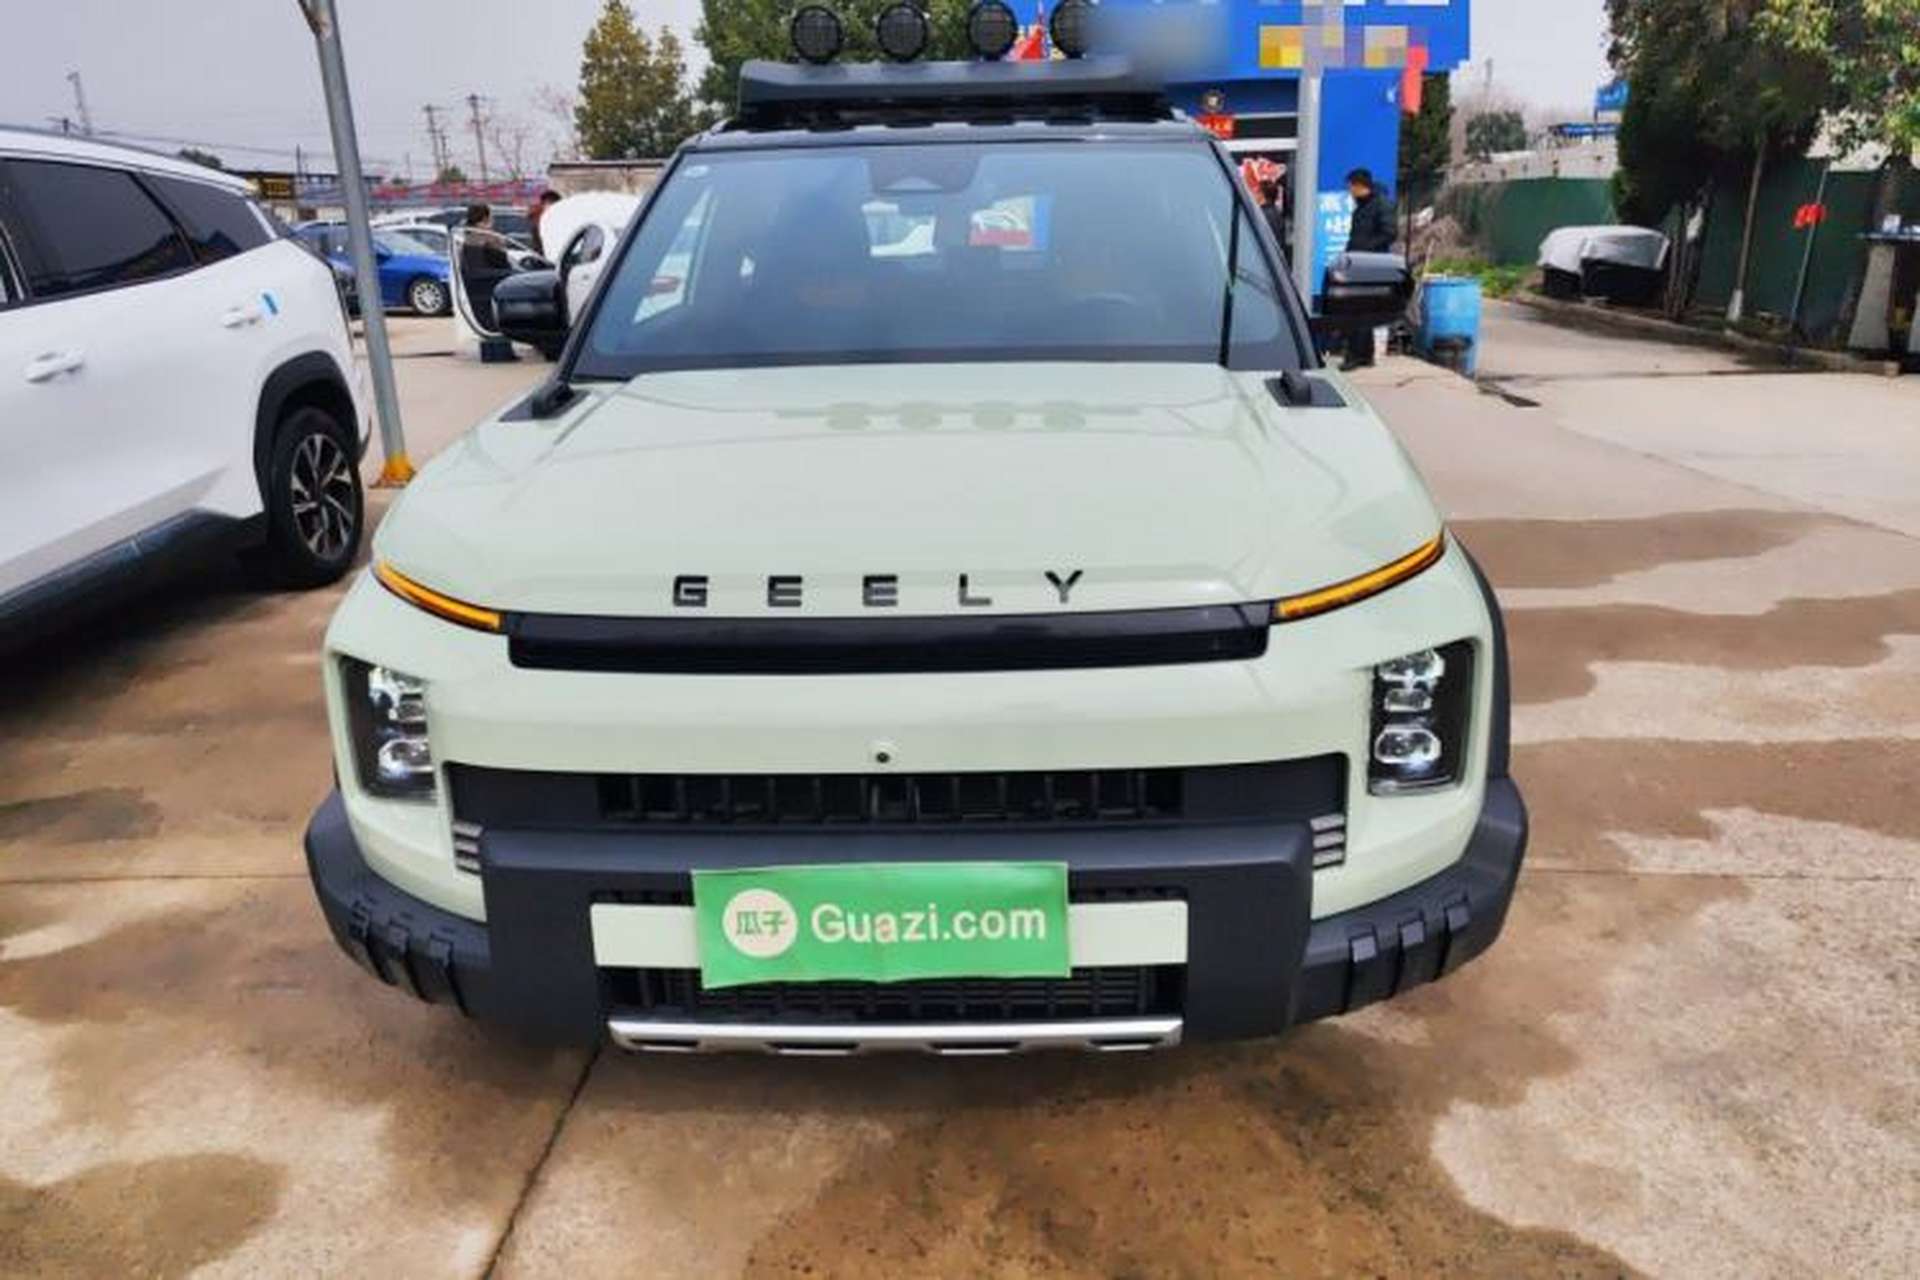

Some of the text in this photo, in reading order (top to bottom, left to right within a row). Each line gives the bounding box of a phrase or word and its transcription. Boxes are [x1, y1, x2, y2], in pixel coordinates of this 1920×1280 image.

[673, 570, 1083, 607] GEELY
[736, 910, 787, 937] 瓜子
[811, 903, 1047, 943] Guazi.com
